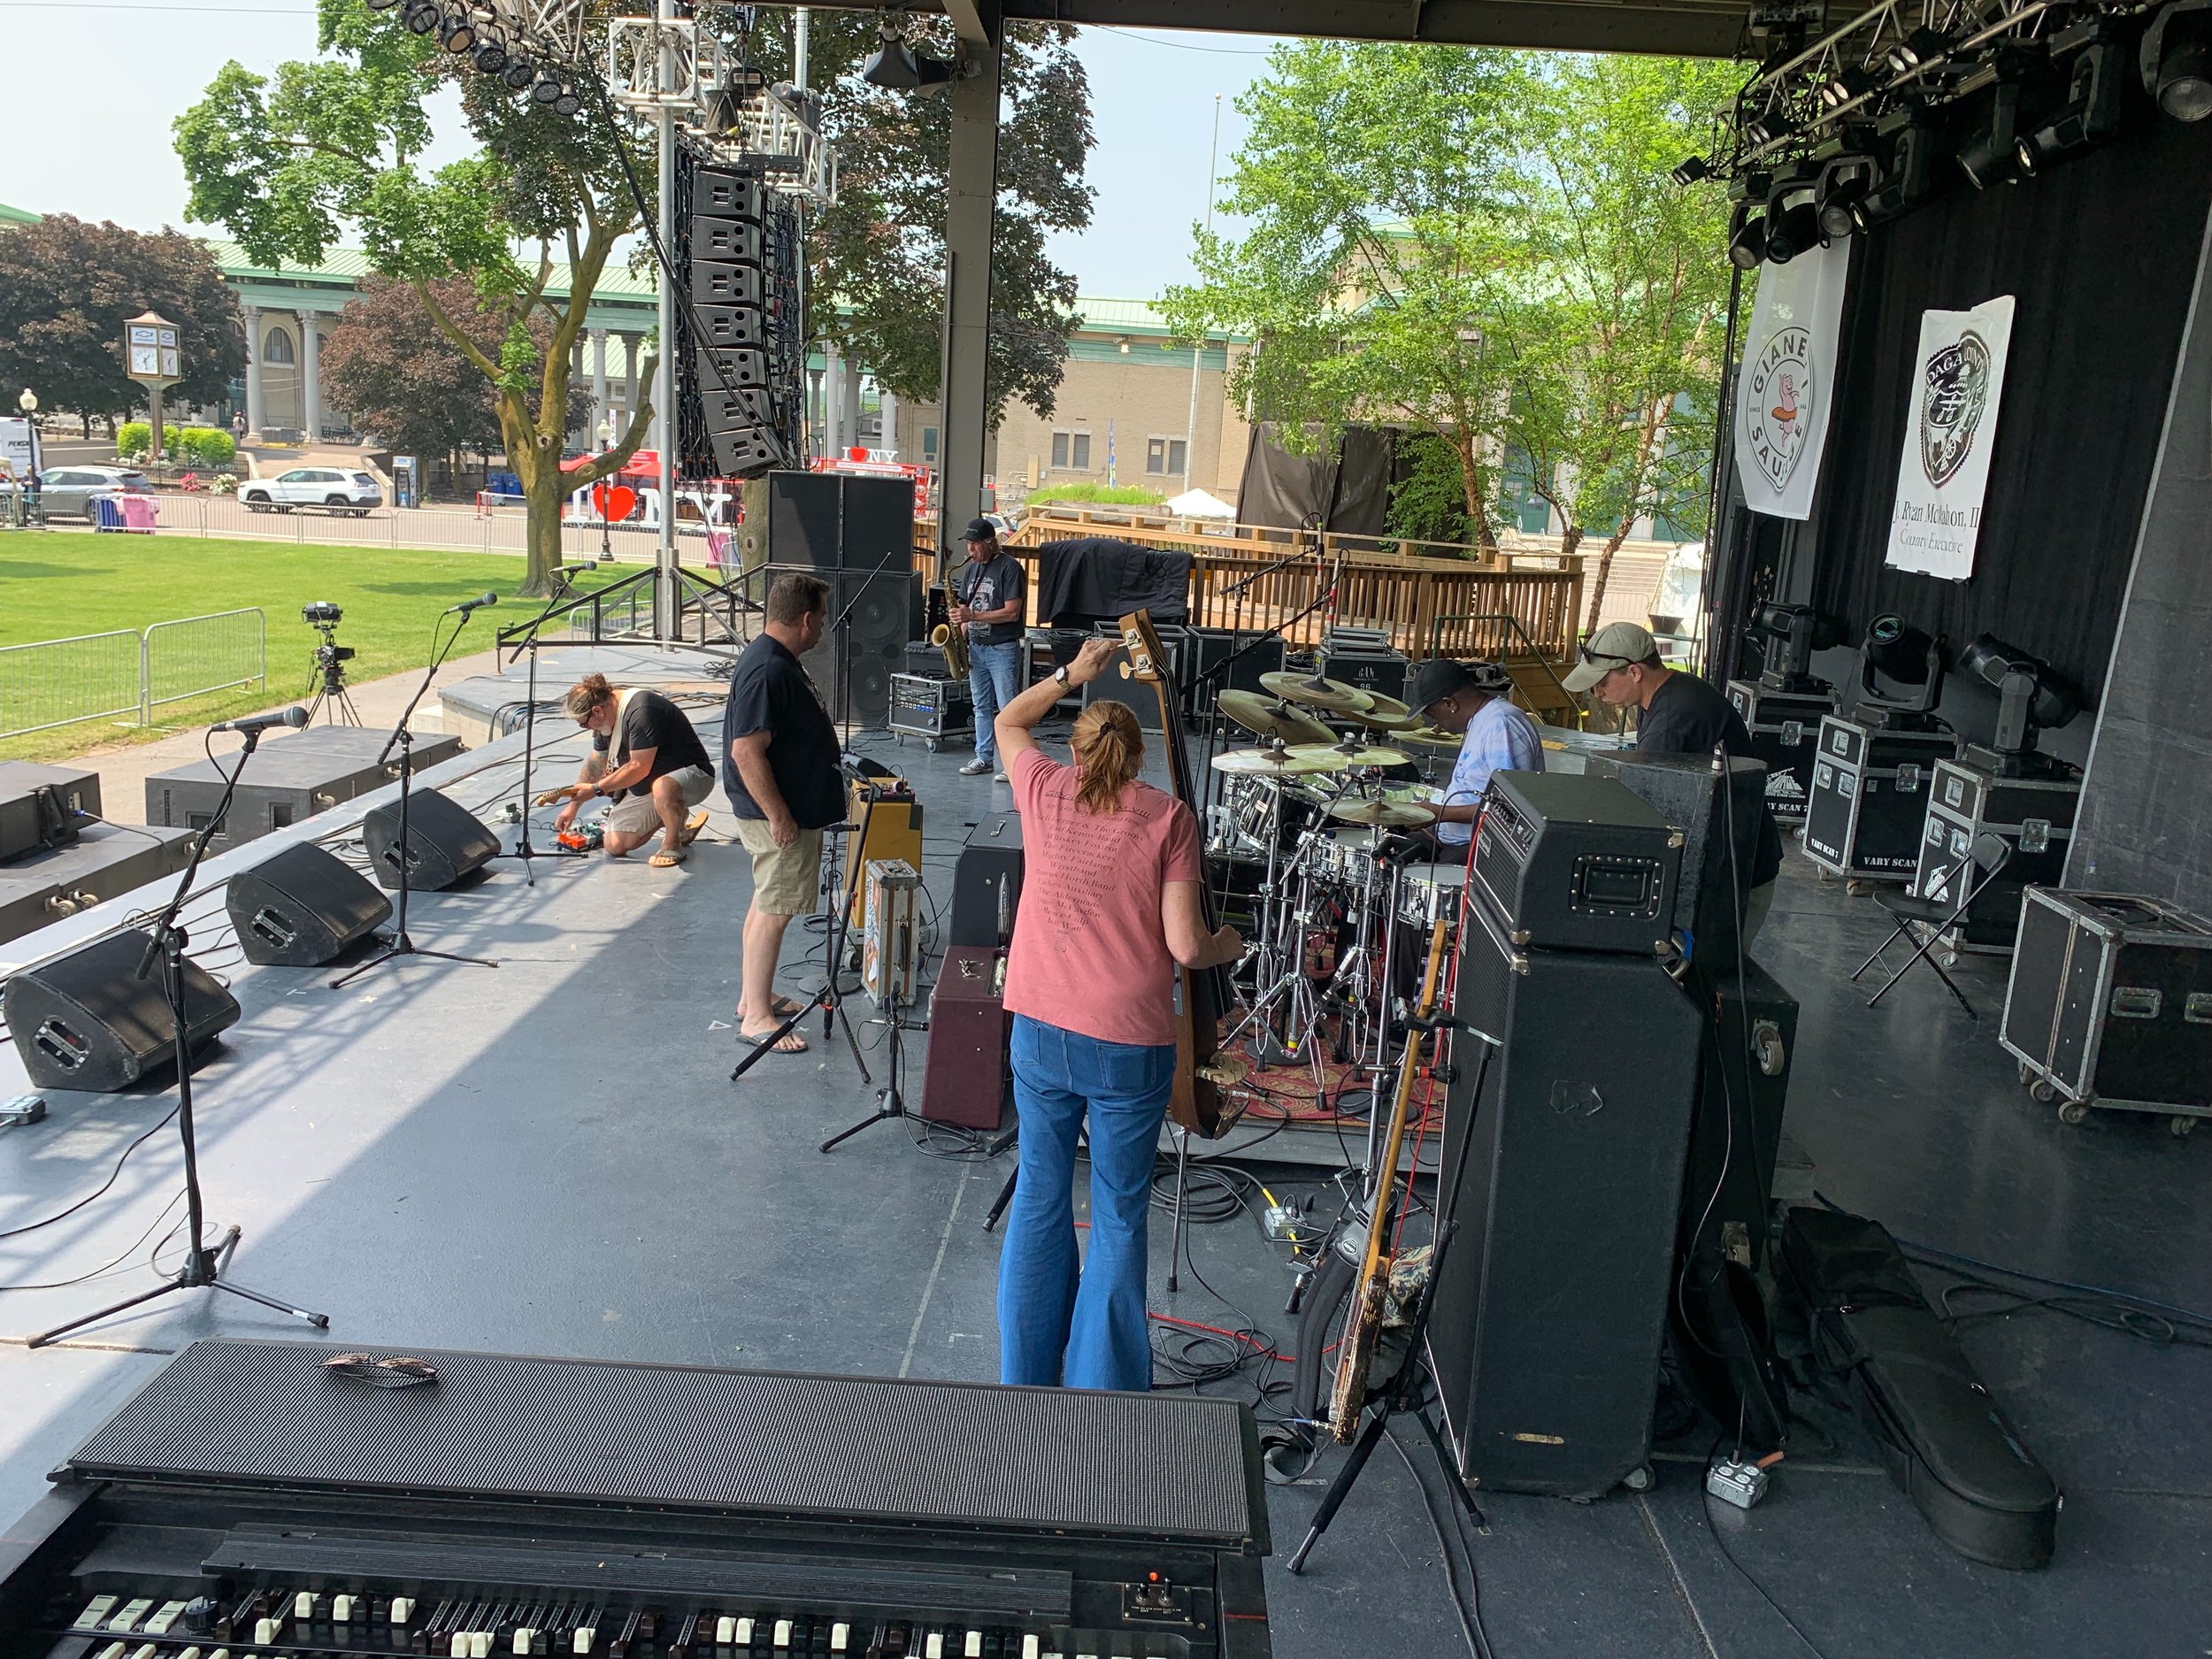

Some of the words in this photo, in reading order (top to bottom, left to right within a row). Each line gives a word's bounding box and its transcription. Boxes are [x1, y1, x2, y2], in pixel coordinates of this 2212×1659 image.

[841, 447, 850, 460] I
[868, 449, 898, 465] NY
[1901, 501, 1924, 526] Ryan
[1970, 507, 1981, 528] II
[1900, 528, 1926, 554] County
[1778, 803, 1801, 812] SCAN
[1066, 827, 1095, 840] Kenny
[1097, 833, 1121, 844] Band
[1094, 824, 1111, 833] The
[1113, 828, 1146, 842] Groove
[1047, 833, 1083, 845] Whiskey
[1084, 840, 1118, 853] Foxtrot
[1811, 838, 1824, 850] VARY
[1823, 843, 1835, 856] SCAN
[1042, 850, 1067, 862] Mighty
[1043, 841, 1056, 850] The
[1059, 844, 1117, 863] Firecrackers
[1050, 861, 1098, 877] Wristband
[1863, 856, 1889, 866] VARY
[1892, 858, 1918, 868] SCAN
[1039, 887, 1052, 896] The
[1064, 884, 1103, 901] Auxiliary
[1091, 879, 1116, 892] Band
